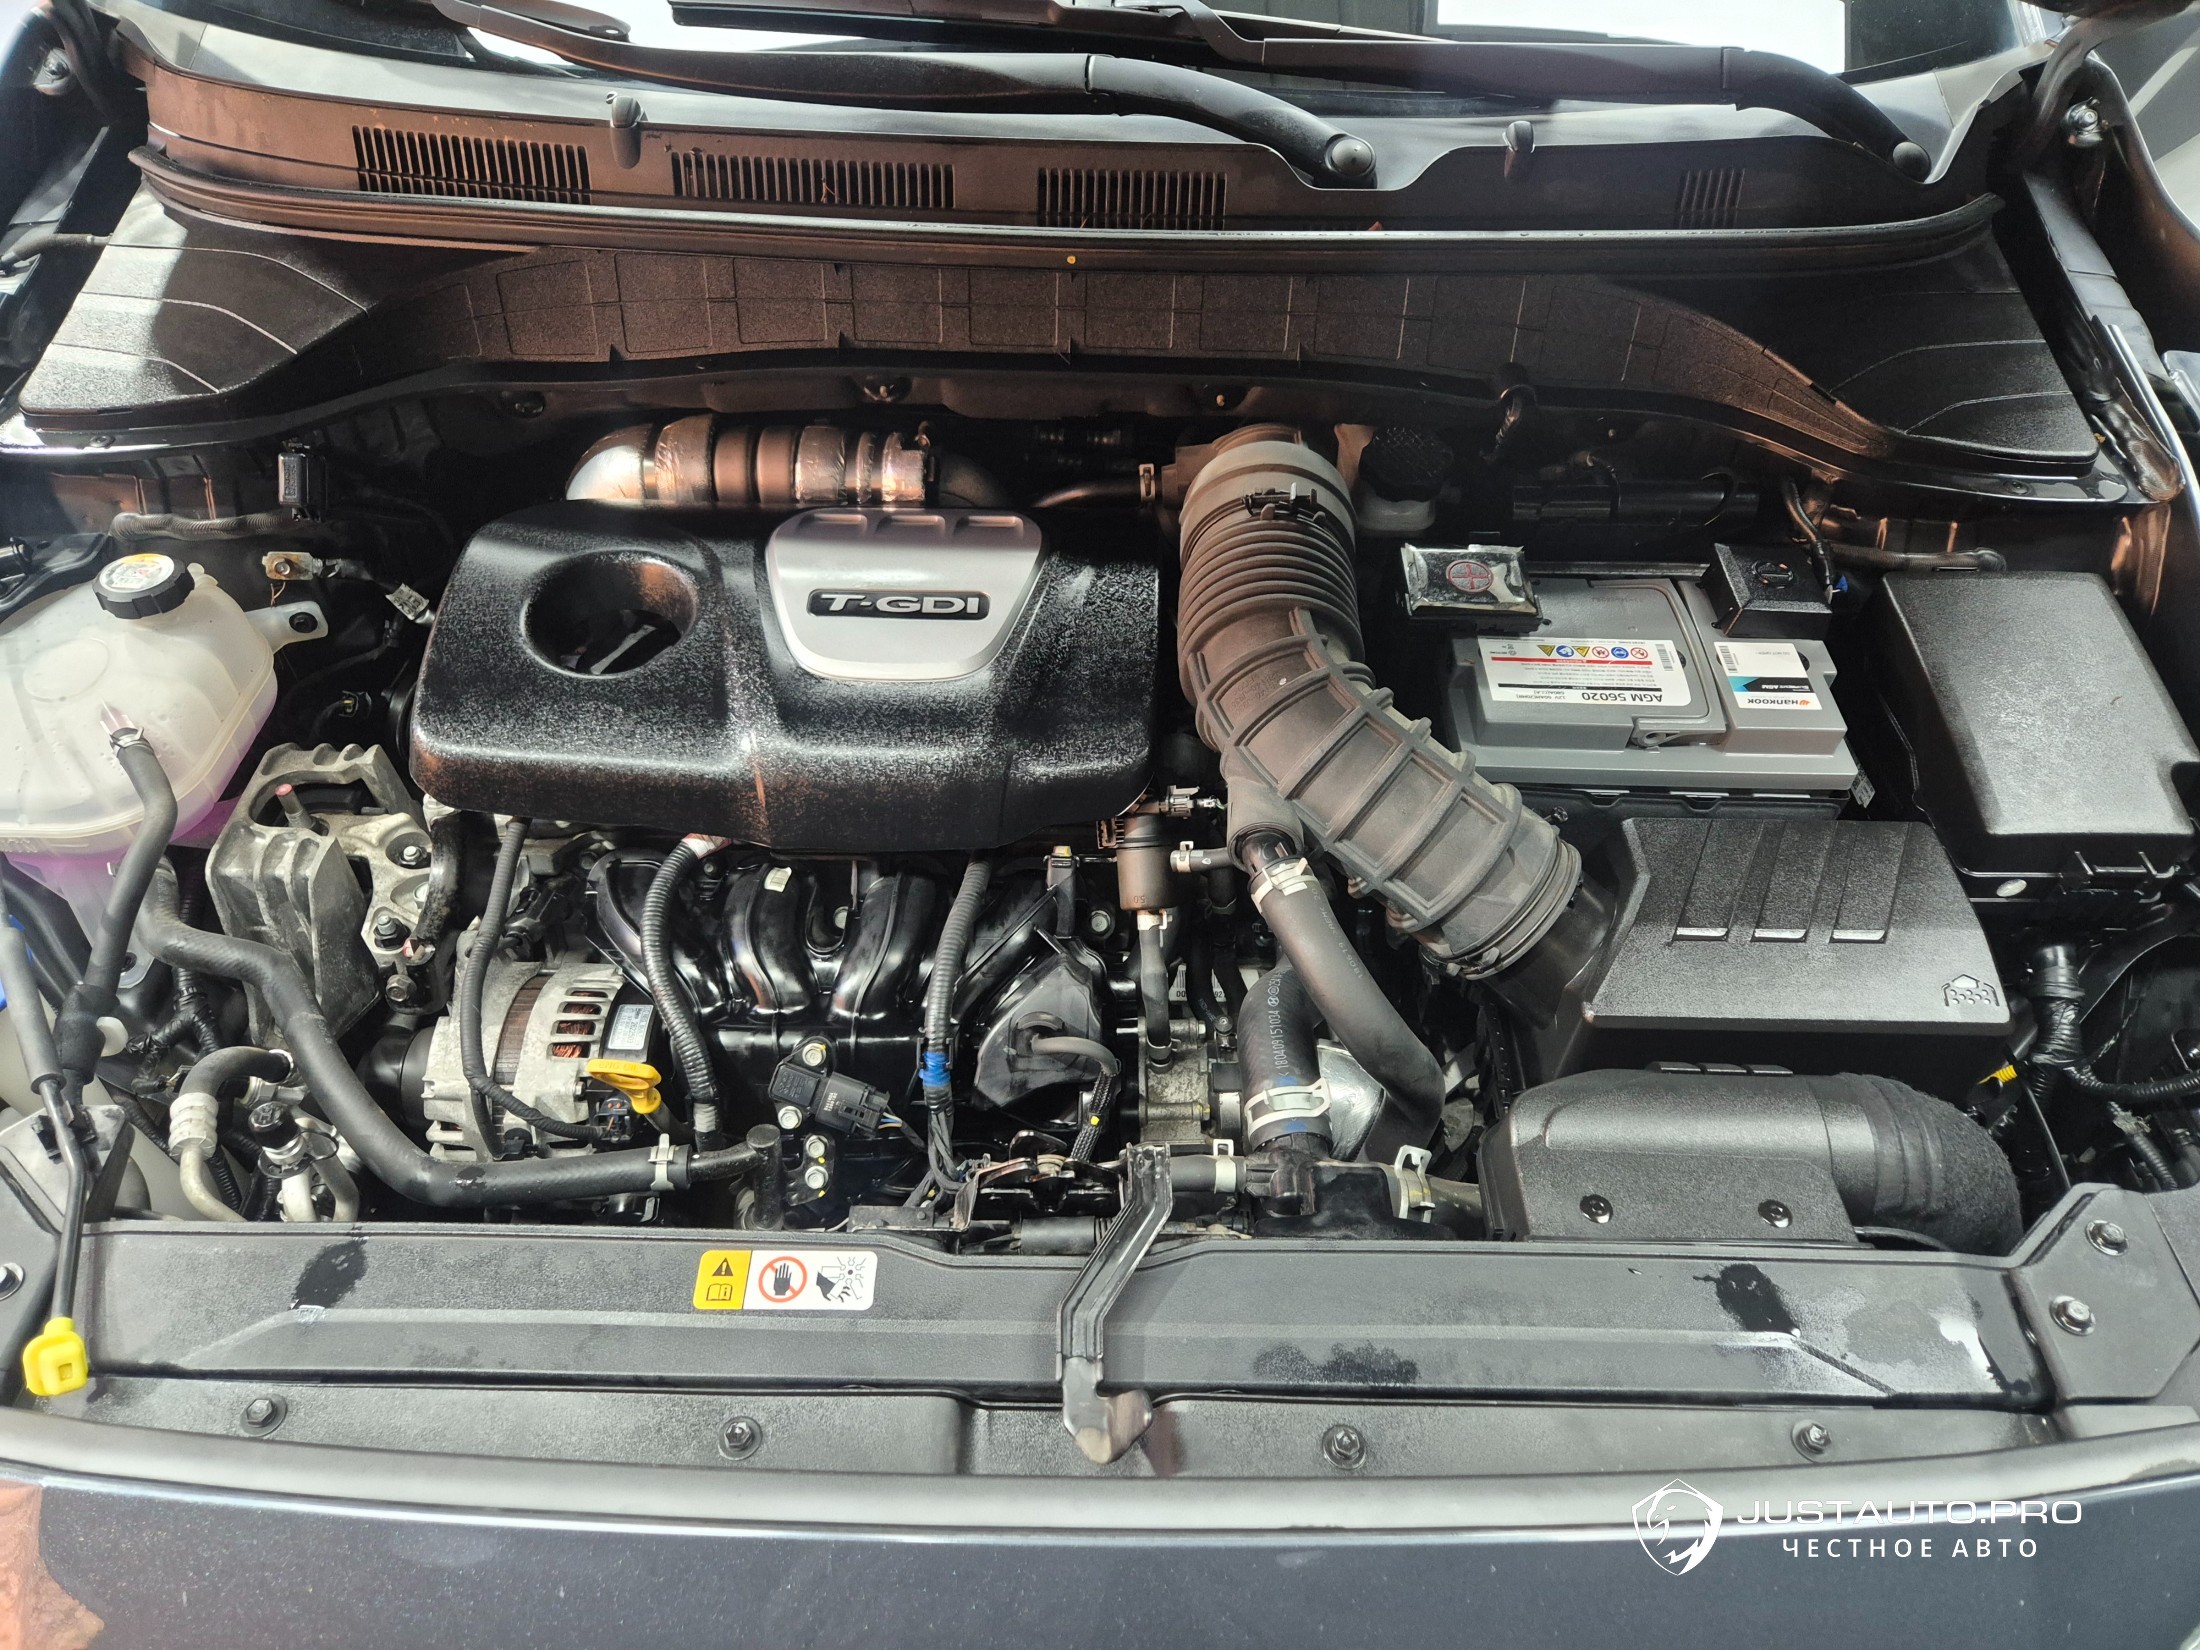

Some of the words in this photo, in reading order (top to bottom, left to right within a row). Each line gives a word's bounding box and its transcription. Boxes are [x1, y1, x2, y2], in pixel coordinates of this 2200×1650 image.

[820, 593, 980, 615] T-GDI
[1581, 691, 1627, 703] 56020
[1630, 692, 1663, 703] AGM
[1268, 1010, 1290, 1070] 180409151034
[598, 1061, 619, 1070] ENG
